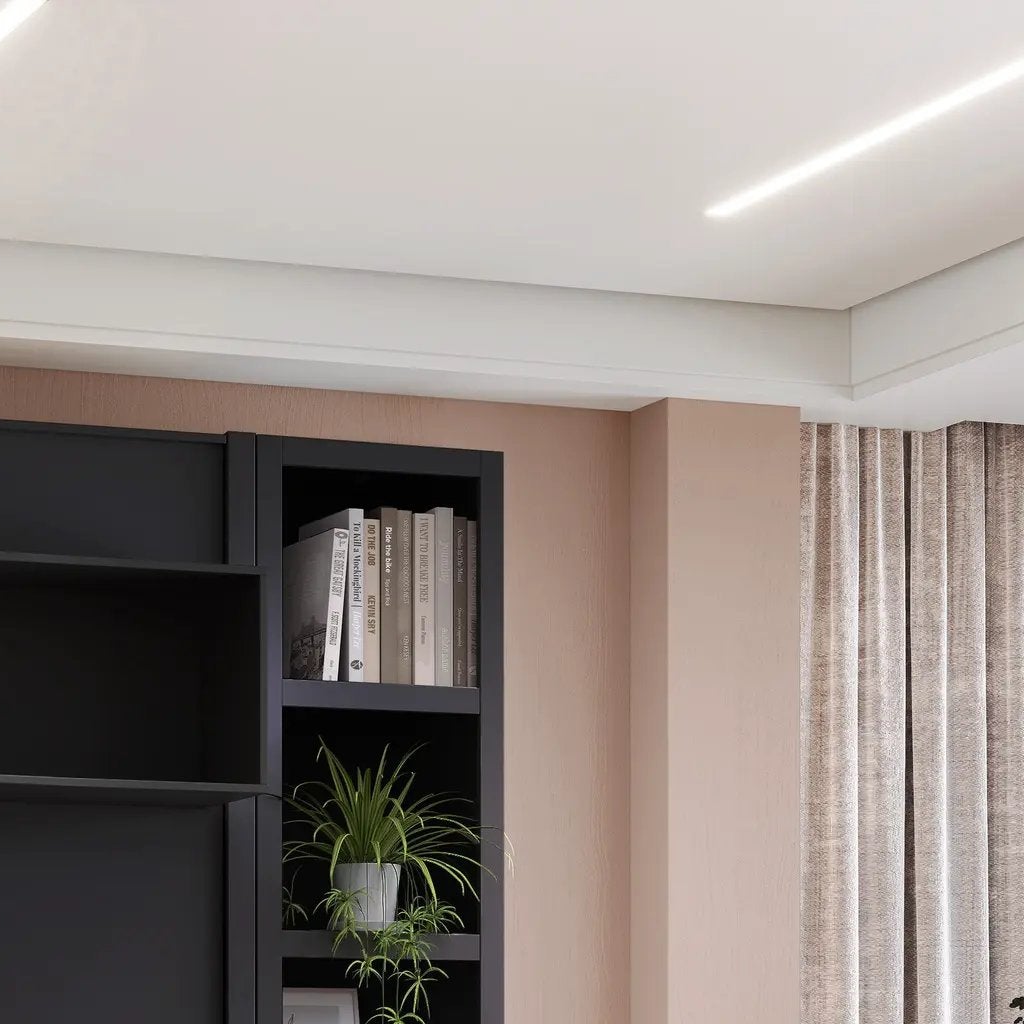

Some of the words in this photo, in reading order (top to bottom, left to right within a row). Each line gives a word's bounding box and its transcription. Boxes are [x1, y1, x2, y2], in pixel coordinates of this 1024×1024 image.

[353, 522, 361, 532] To
[367, 524, 375, 535] DO
[420, 522, 428, 541] WANT
[353, 533, 362, 547] Kill
[367, 536, 375, 551] THE
[420, 542, 428, 552] TO
[335, 550, 345, 559] THE
[367, 552, 375, 566] JOB
[334, 560, 344, 576] GREAT
[352, 554, 362, 602] Mockingbird
[332, 577, 343, 598] GATSBY
[420, 583, 429, 603] FREE
[367, 595, 376, 618] KEVIN
